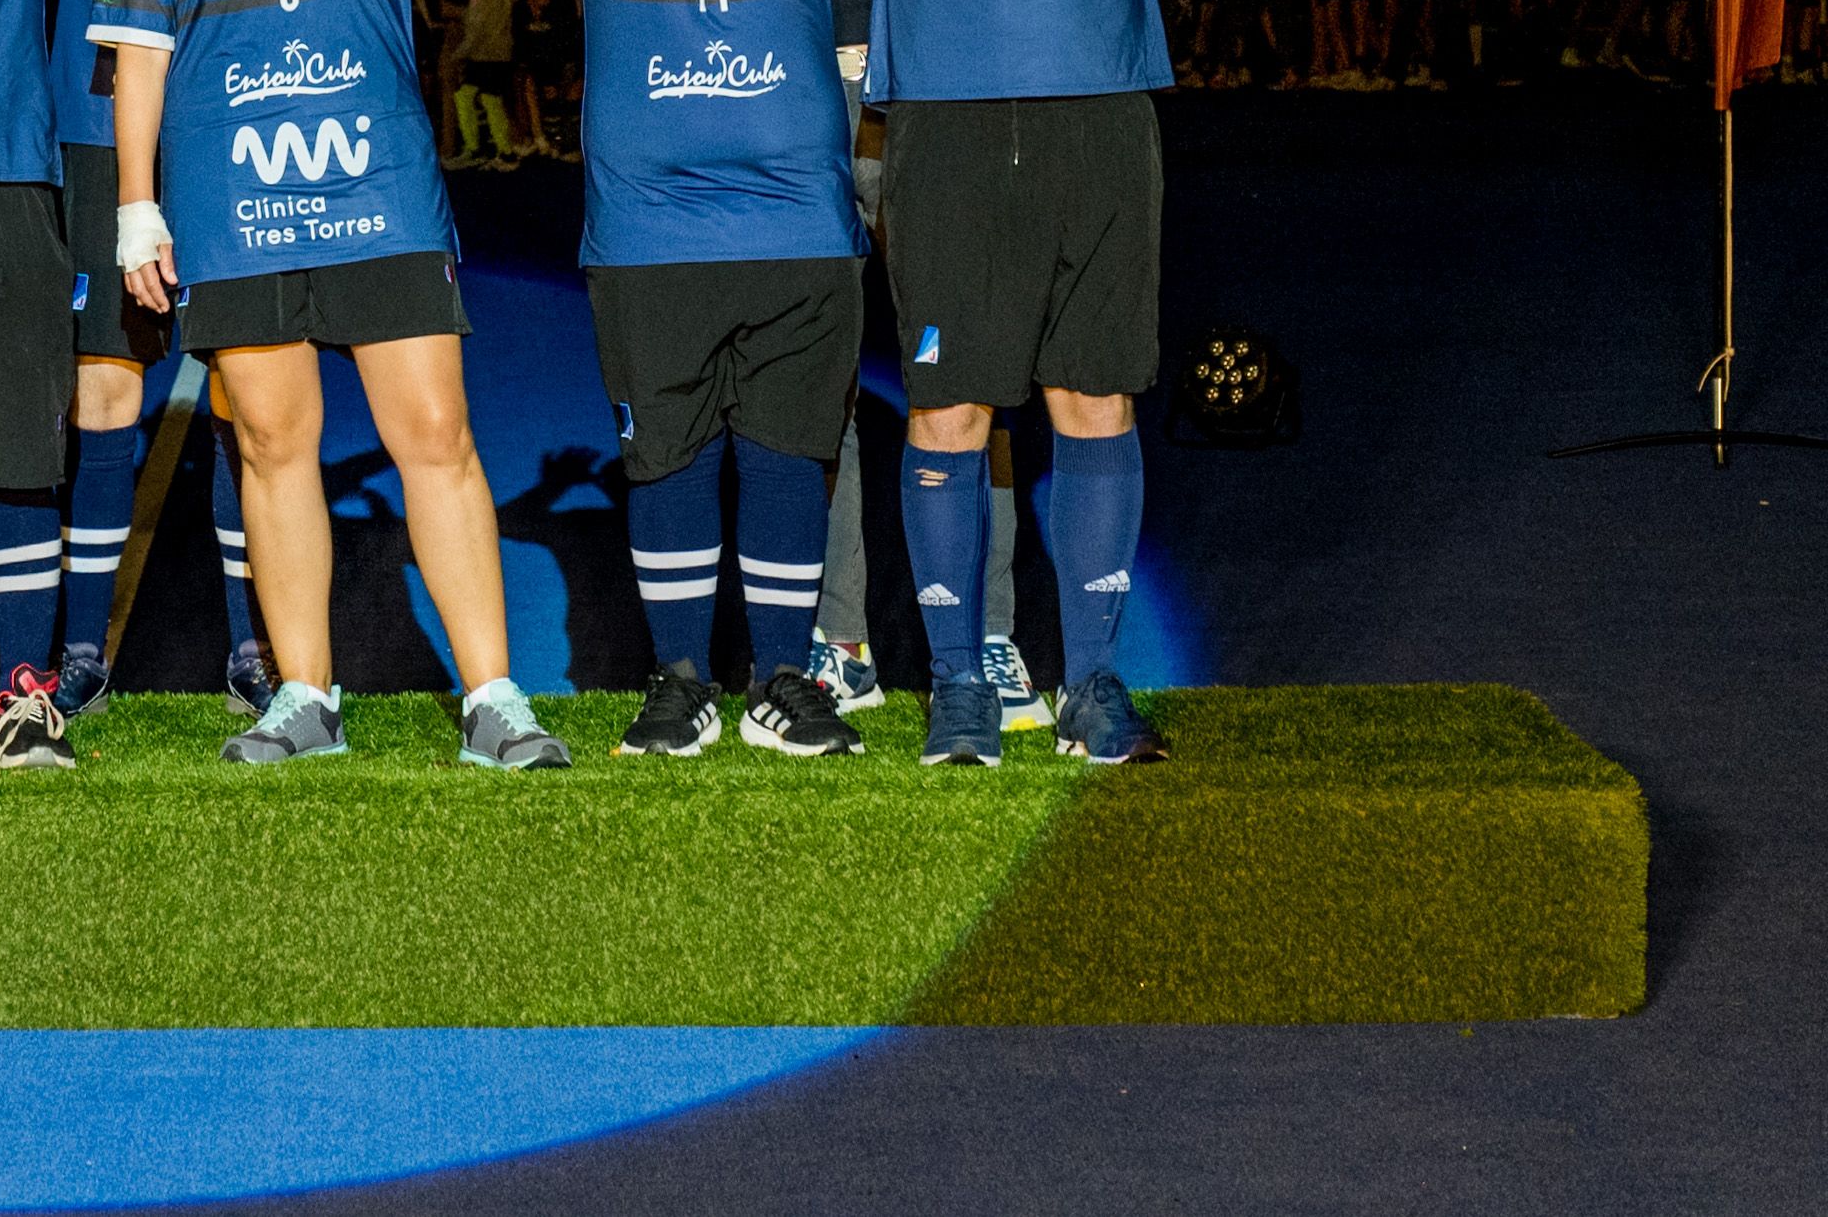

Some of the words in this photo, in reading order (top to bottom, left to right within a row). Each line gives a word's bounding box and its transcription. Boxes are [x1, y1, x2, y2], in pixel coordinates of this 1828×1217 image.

[225, 57, 305, 99] Enjoy
[305, 48, 367, 84] Cuba
[647, 52, 727, 96] Enjoy
[727, 50, 787, 87] Cuba
[236, 194, 327, 222] Clínica
[239, 227, 297, 250] Tres
[304, 214, 387, 241] Torres
